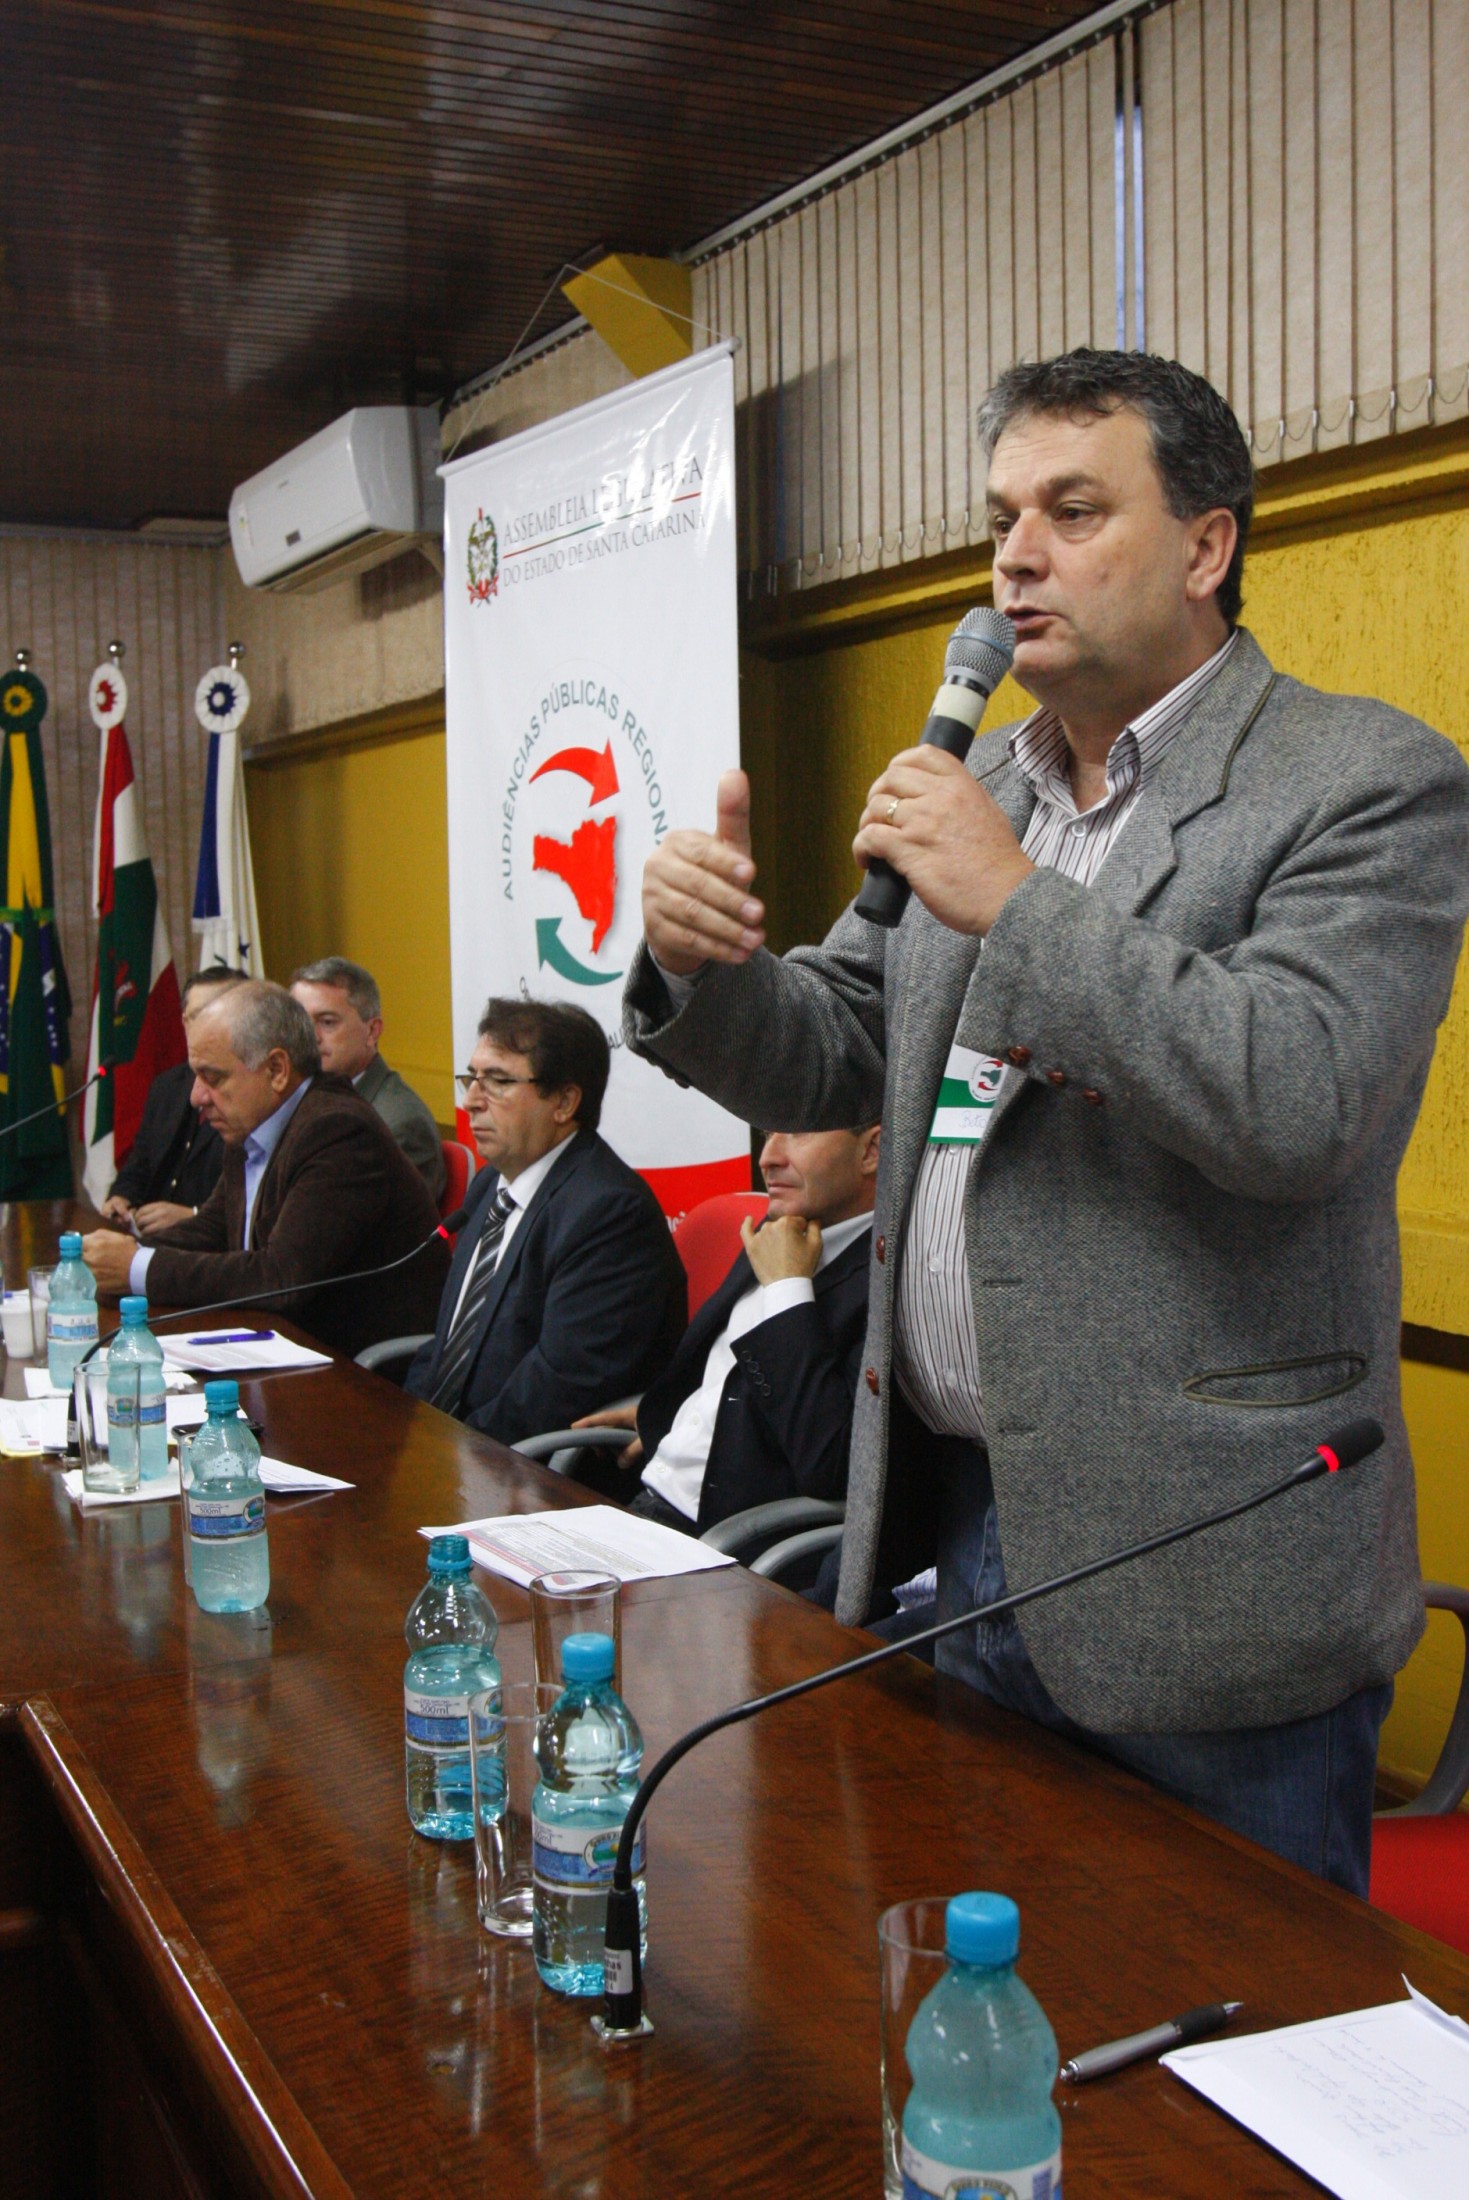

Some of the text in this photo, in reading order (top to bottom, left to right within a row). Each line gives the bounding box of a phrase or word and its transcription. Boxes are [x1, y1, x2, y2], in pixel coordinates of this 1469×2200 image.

[503, 493, 587, 546] ASSEMBLEIA
[503, 565, 521, 587] DO
[524, 549, 565, 581] ESTADO
[568, 542, 584, 567] DE
[586, 531, 629, 561] SANTA
[501, 679, 668, 901] AUDIÊNCIAS PÚBLICAS REGION
